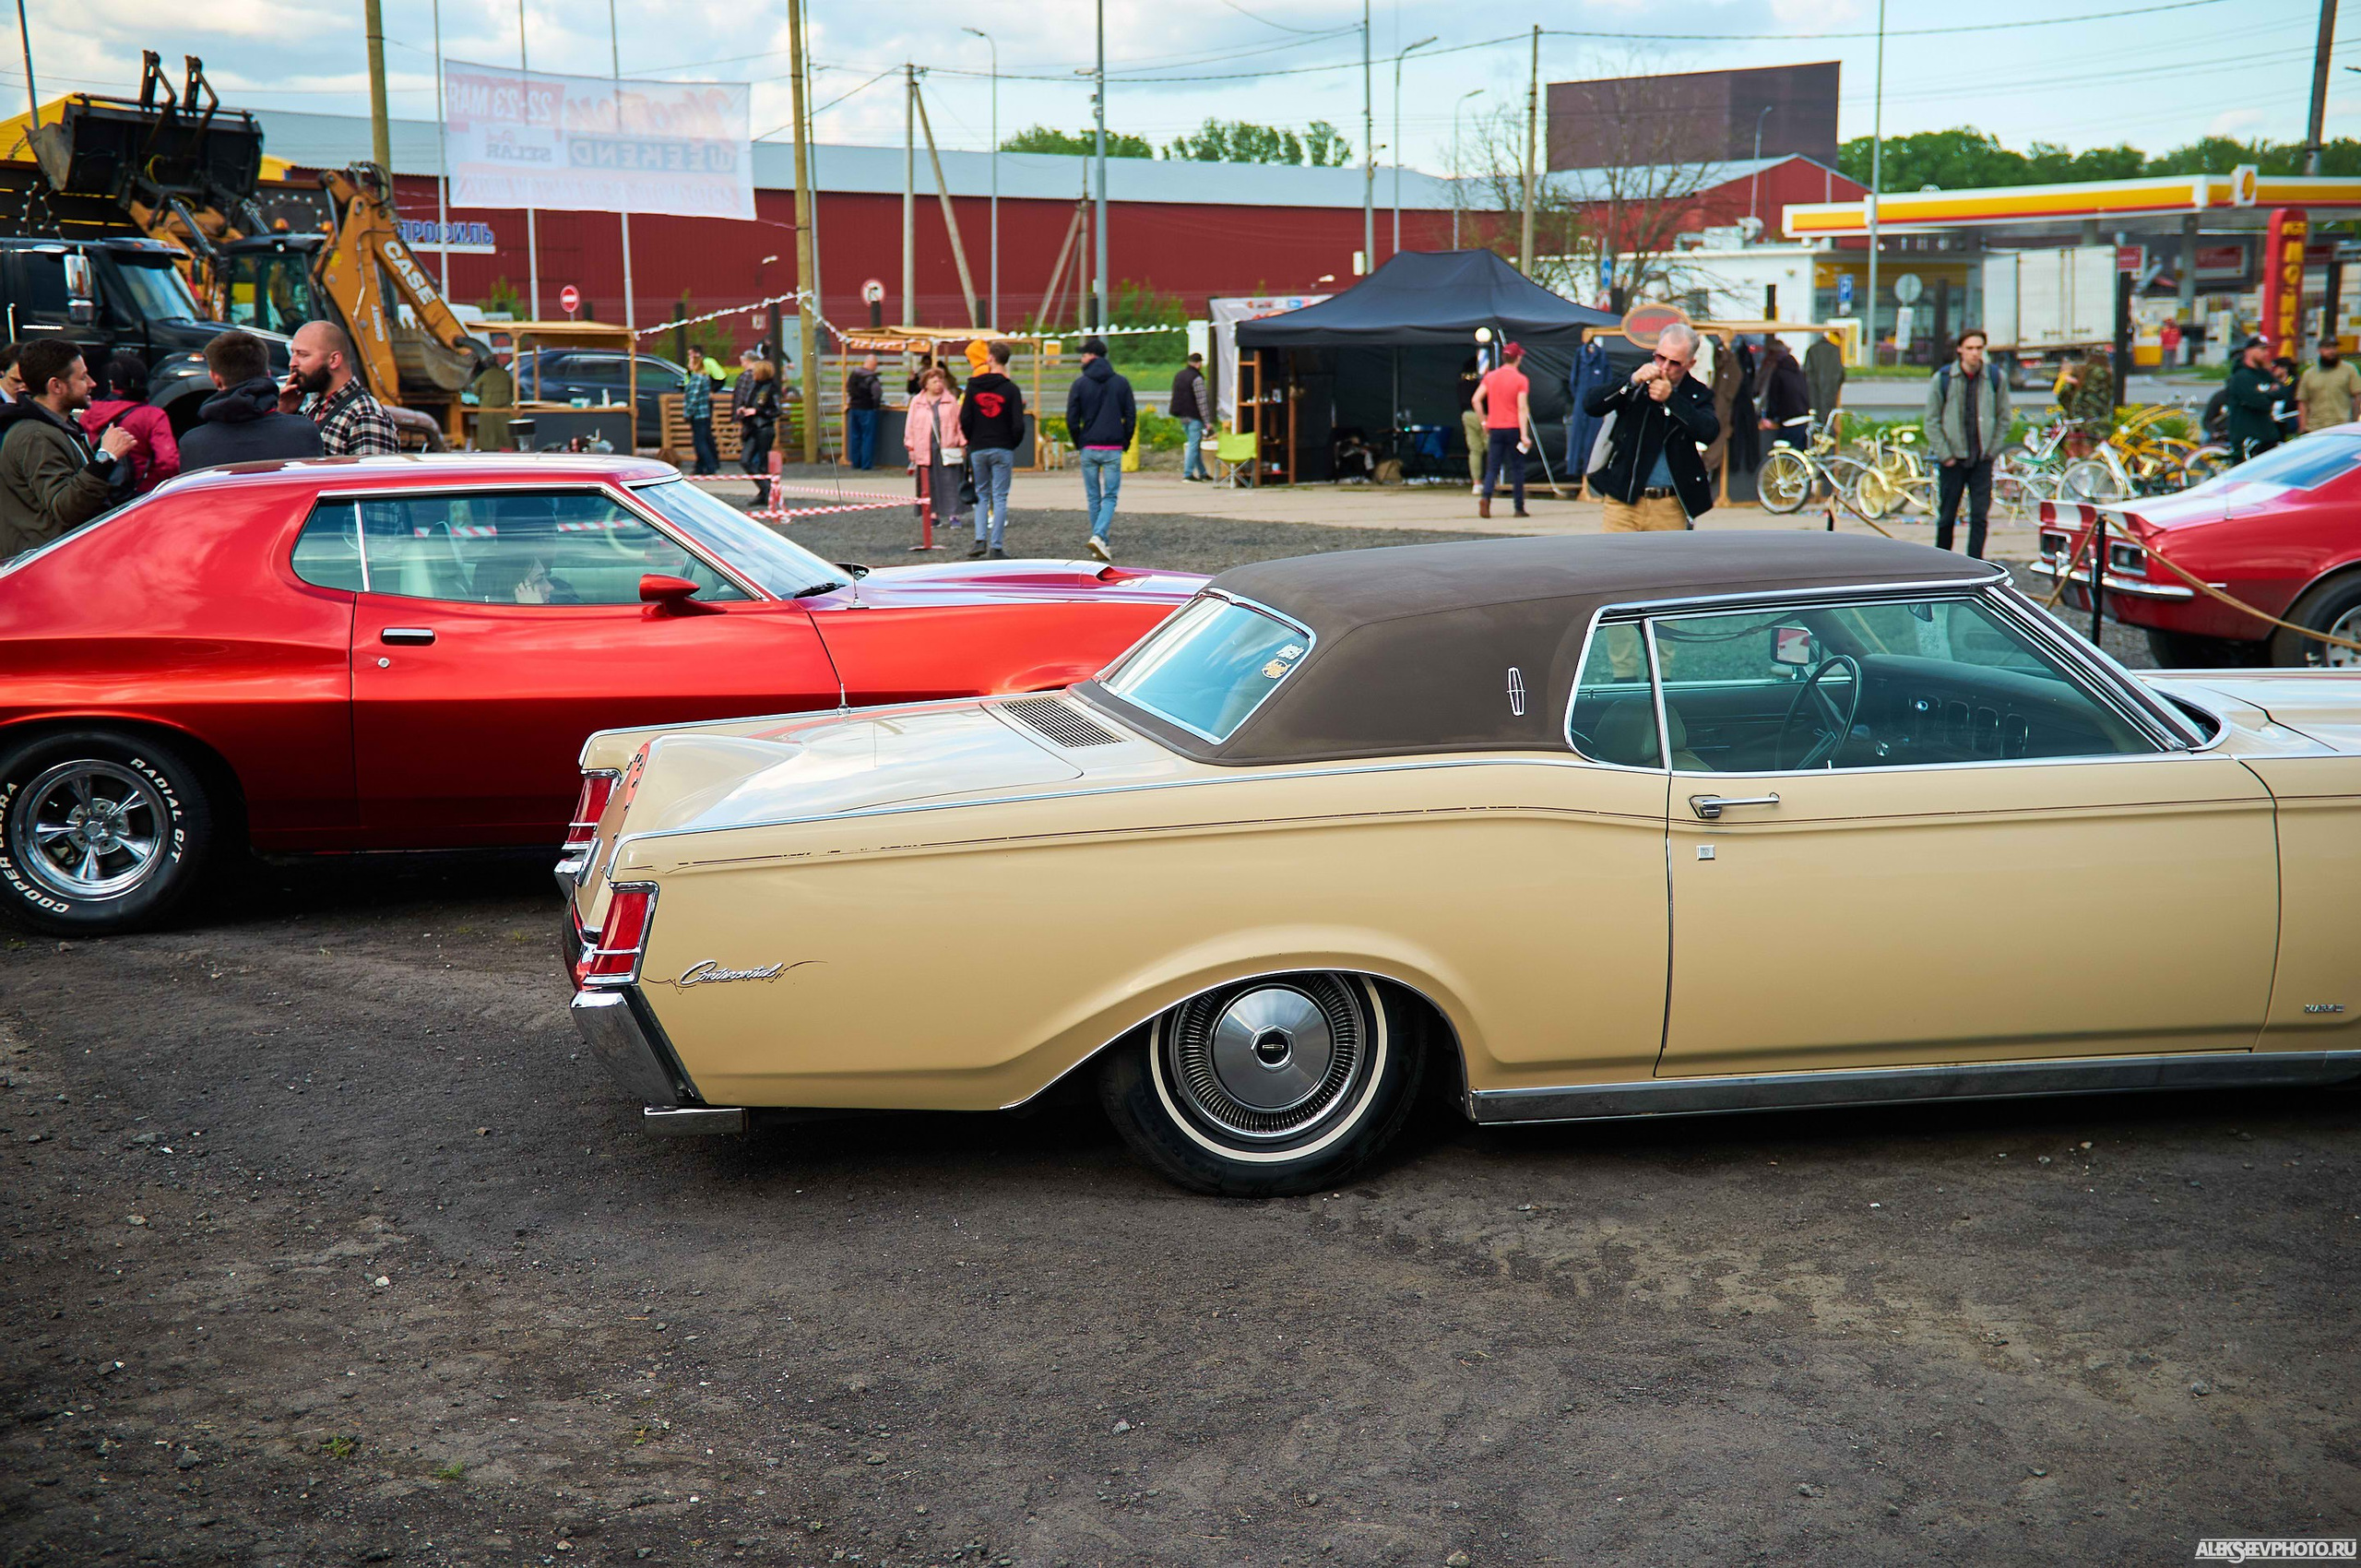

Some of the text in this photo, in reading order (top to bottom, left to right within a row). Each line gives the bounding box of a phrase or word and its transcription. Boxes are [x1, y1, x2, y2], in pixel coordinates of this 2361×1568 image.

[384, 241, 437, 305] CASE
[130, 757, 184, 863] RADIAL G/T
[0, 857, 70, 913] COOPER
[680, 959, 783, 985] Continental
